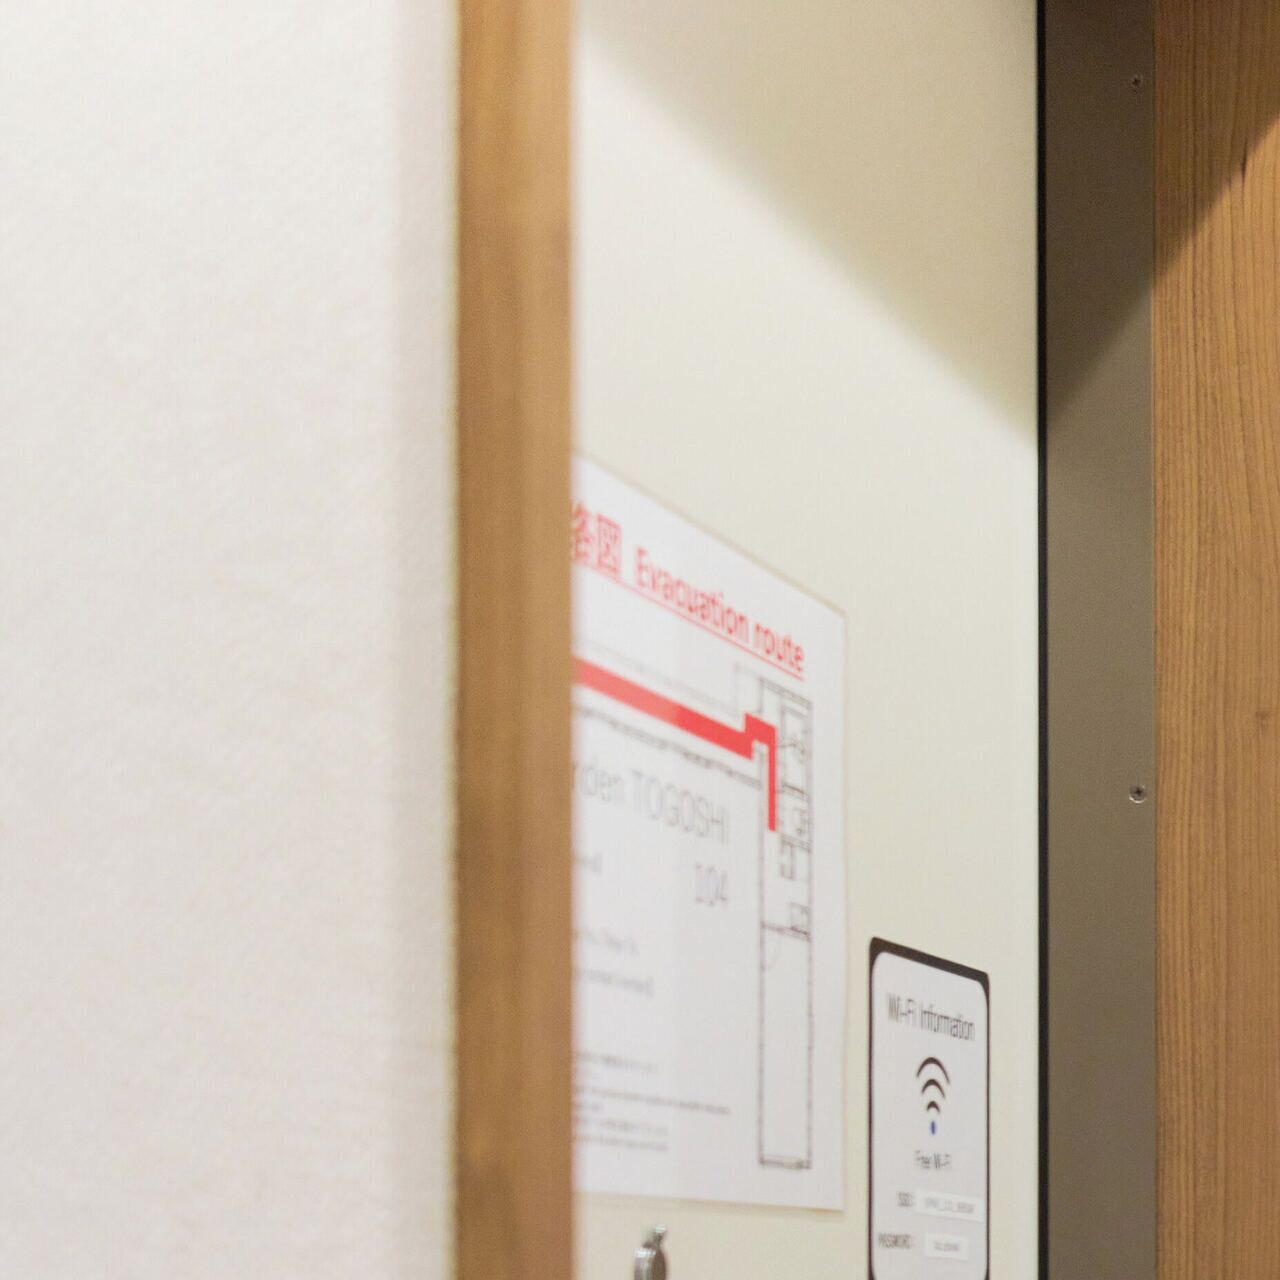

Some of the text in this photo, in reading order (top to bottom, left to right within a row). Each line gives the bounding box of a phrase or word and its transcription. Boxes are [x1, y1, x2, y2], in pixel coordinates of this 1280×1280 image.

[634, 545, 749, 643] Evacuation
[753, 621, 805, 673] route
[886, 992, 976, 1042] Wi-Fi Information
